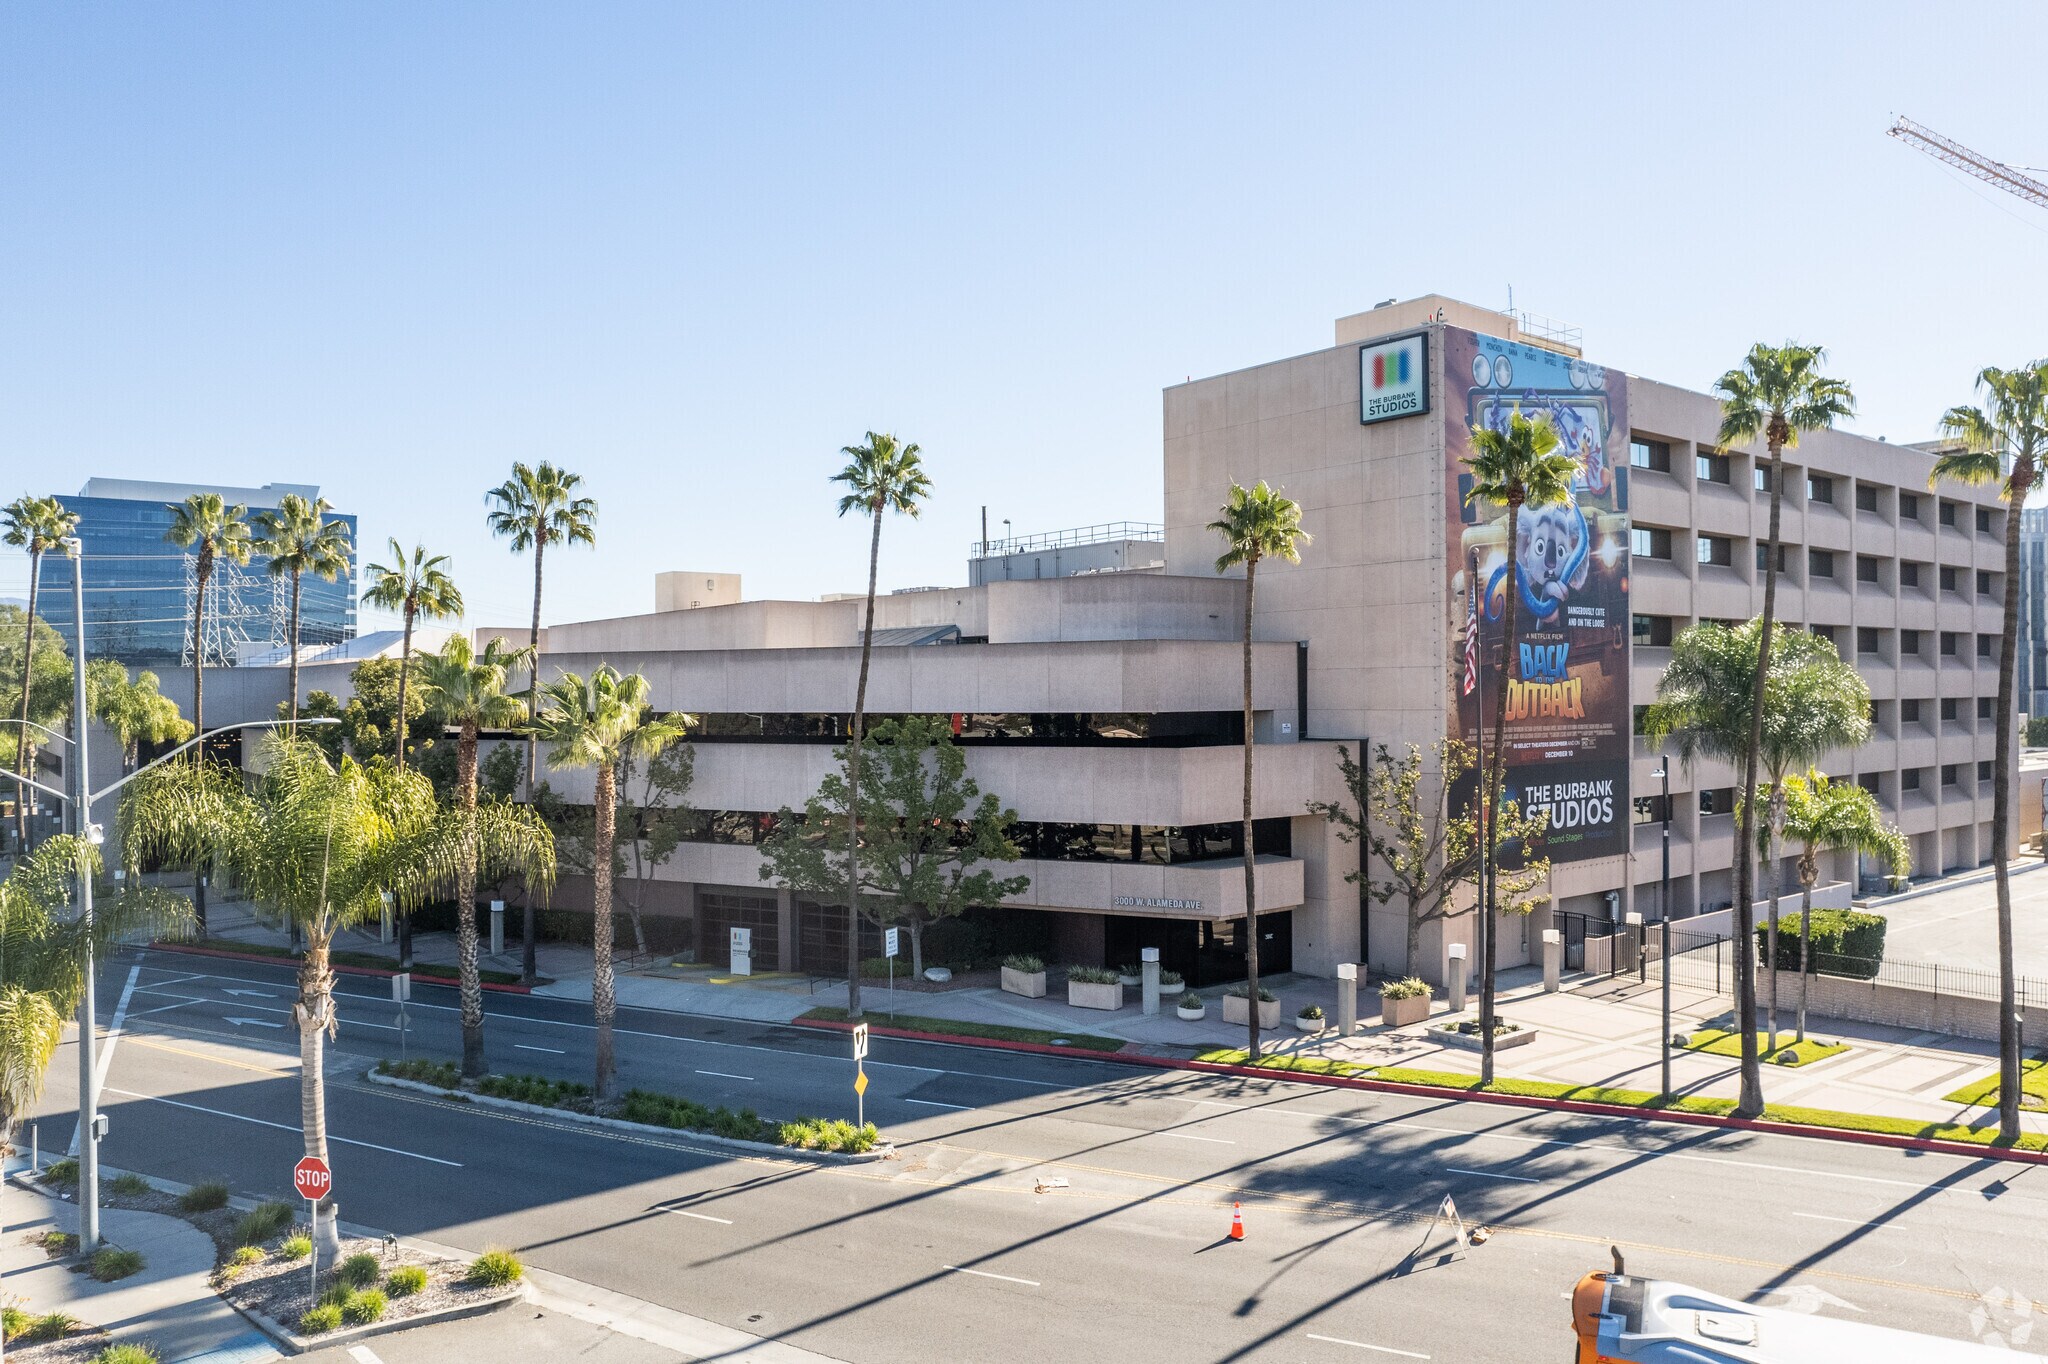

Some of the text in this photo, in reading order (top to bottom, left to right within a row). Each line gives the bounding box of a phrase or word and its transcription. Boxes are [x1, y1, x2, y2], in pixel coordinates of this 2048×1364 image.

[1369, 391, 1416, 406] THE BURBANK
[1369, 398, 1417, 416] STUDIOS
[1568, 606, 1605, 616] DANGEROUSLY CUTE
[1568, 618, 1577, 626] AND
[1584, 619, 1592, 627] THE
[1592, 620, 1605, 628] LOOSE
[1520, 642, 1569, 680] BACK
[1505, 676, 1586, 721] OUTBACK
[1545, 750, 1568, 758] DECEMBER
[1525, 780, 1613, 803] THE BURBANK
[1547, 834, 1564, 845] Sound
[1565, 833, 1583, 843] Stages
[1114, 896, 1204, 910] 3000 W. ALAMEDA AVE.
[297, 1168, 330, 1188] STOP
